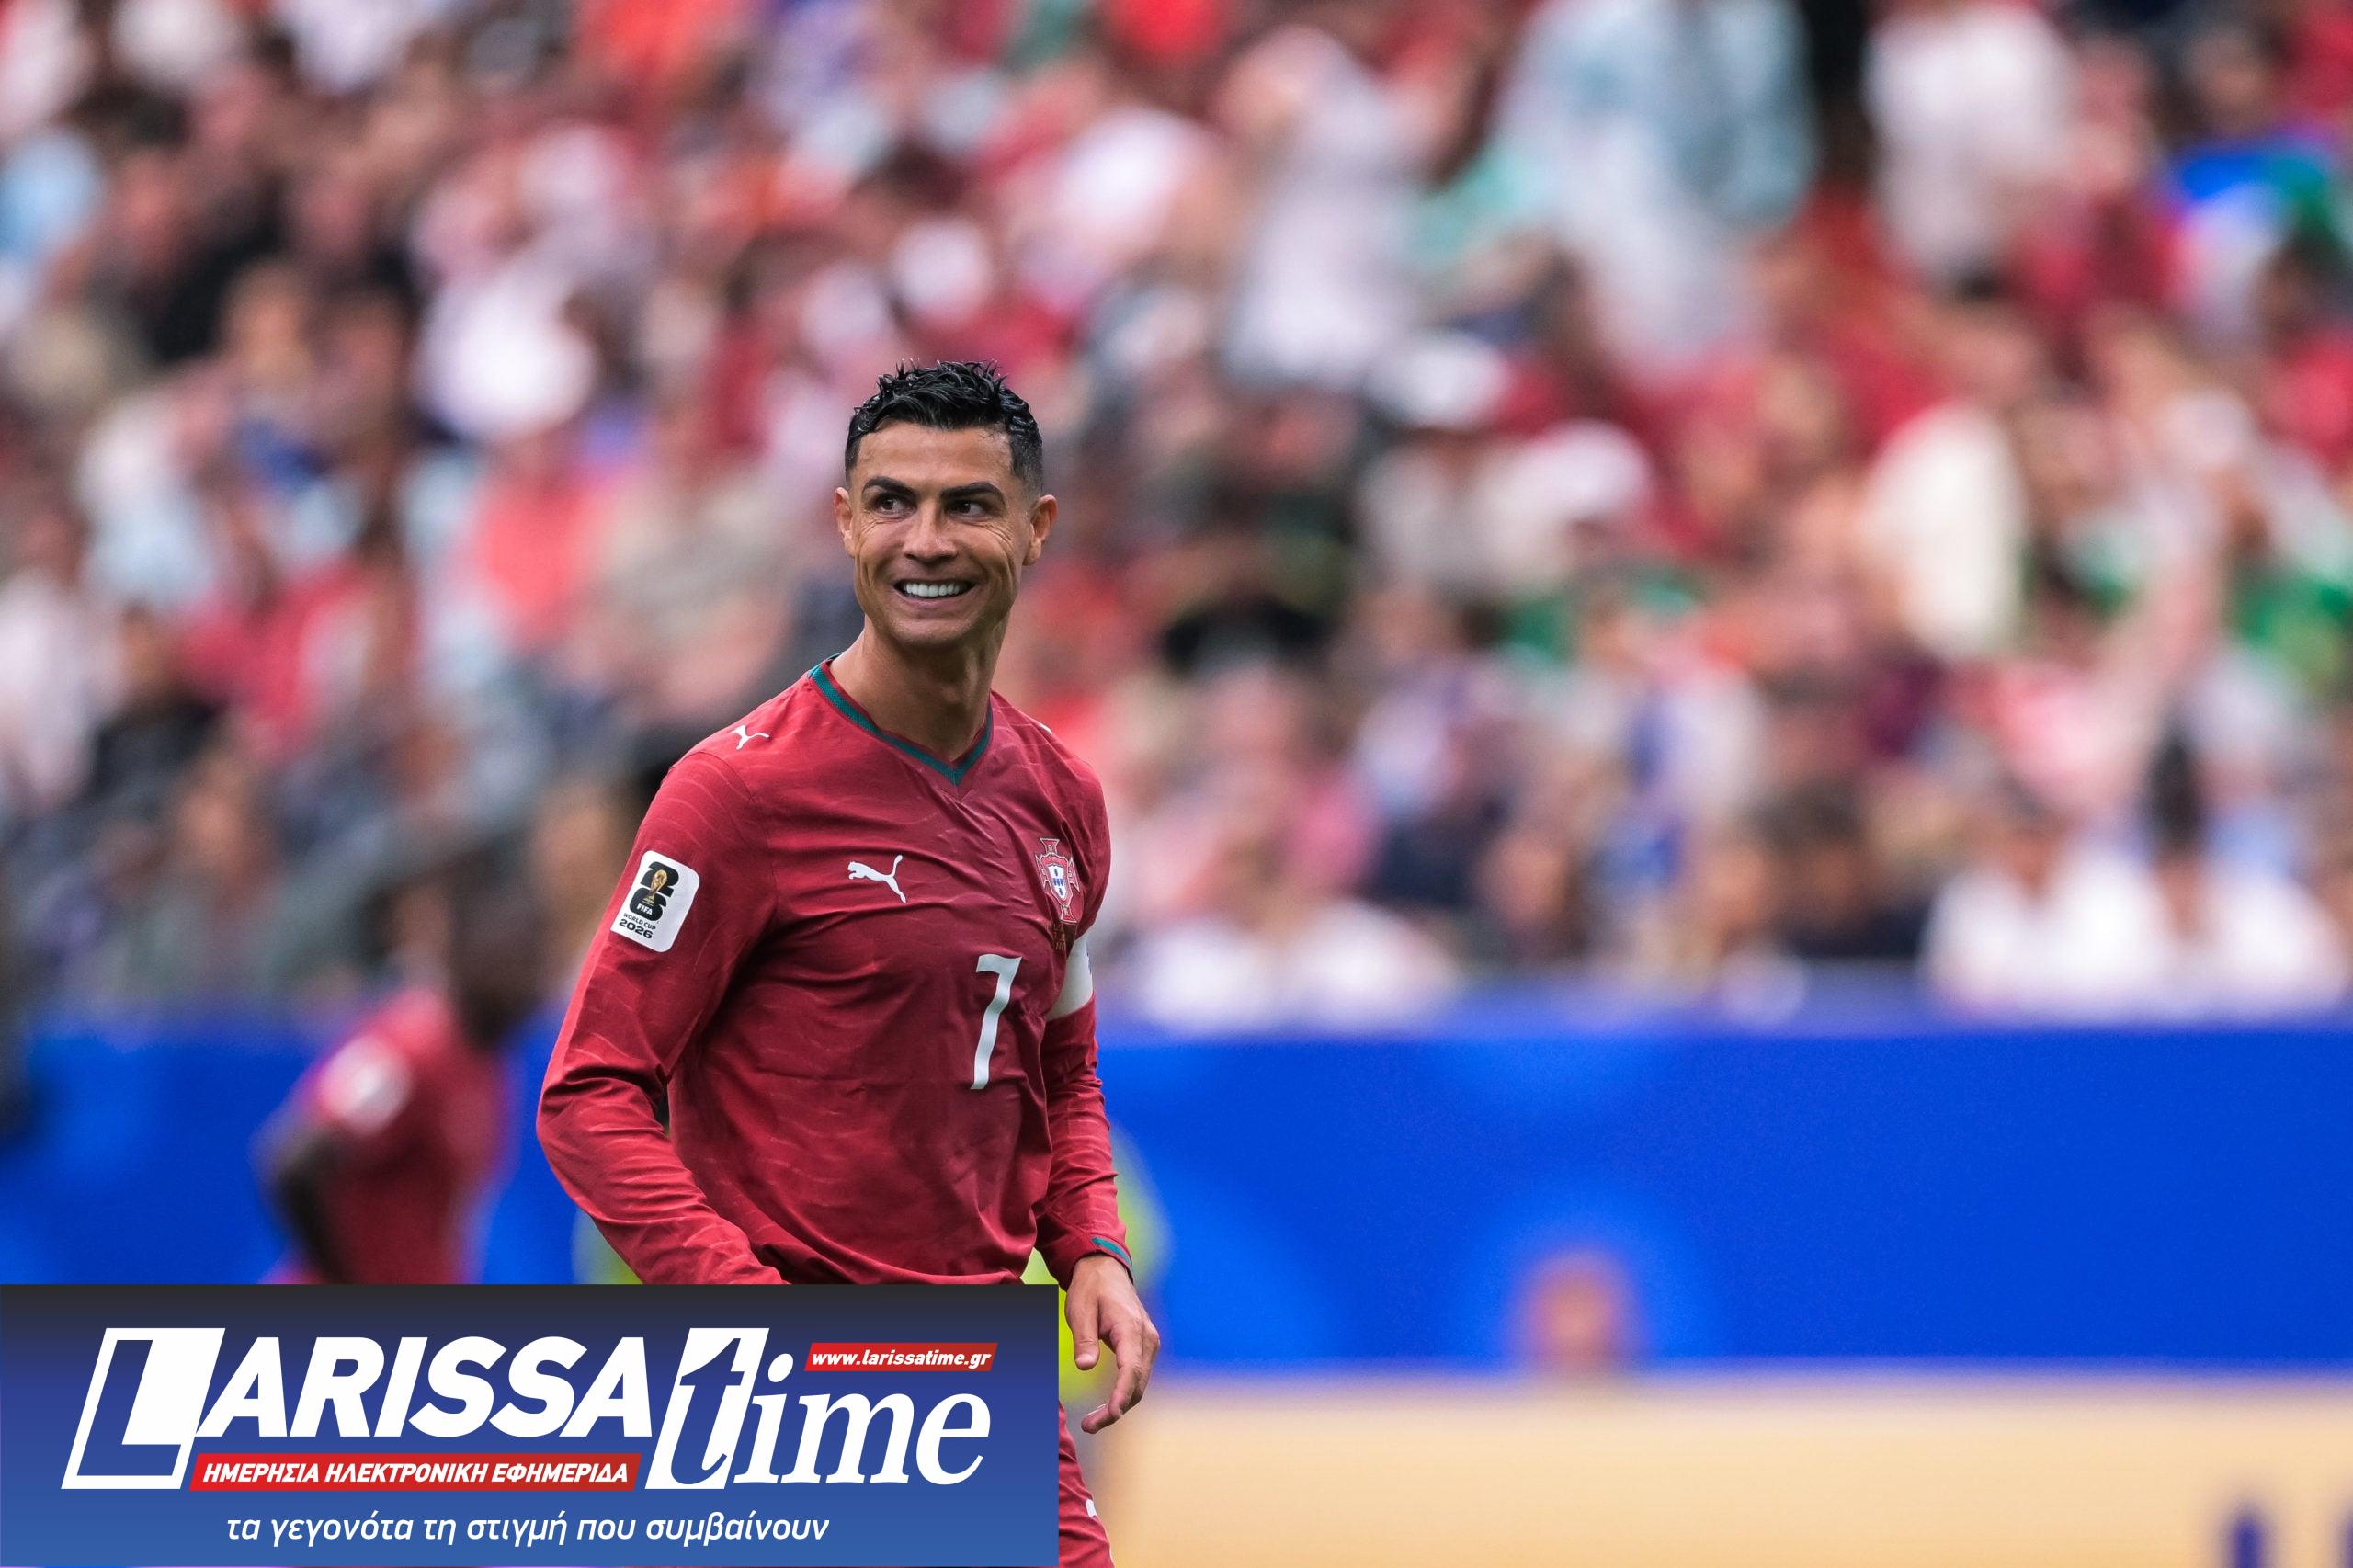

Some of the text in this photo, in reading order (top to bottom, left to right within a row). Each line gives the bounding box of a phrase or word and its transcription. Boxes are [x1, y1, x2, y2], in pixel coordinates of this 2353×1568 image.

[636, 903, 654, 915] FIFA
[619, 918, 654, 939] 2026
[623, 914, 656, 930] WORLD CUP
[970, 953, 1023, 1090] 7
